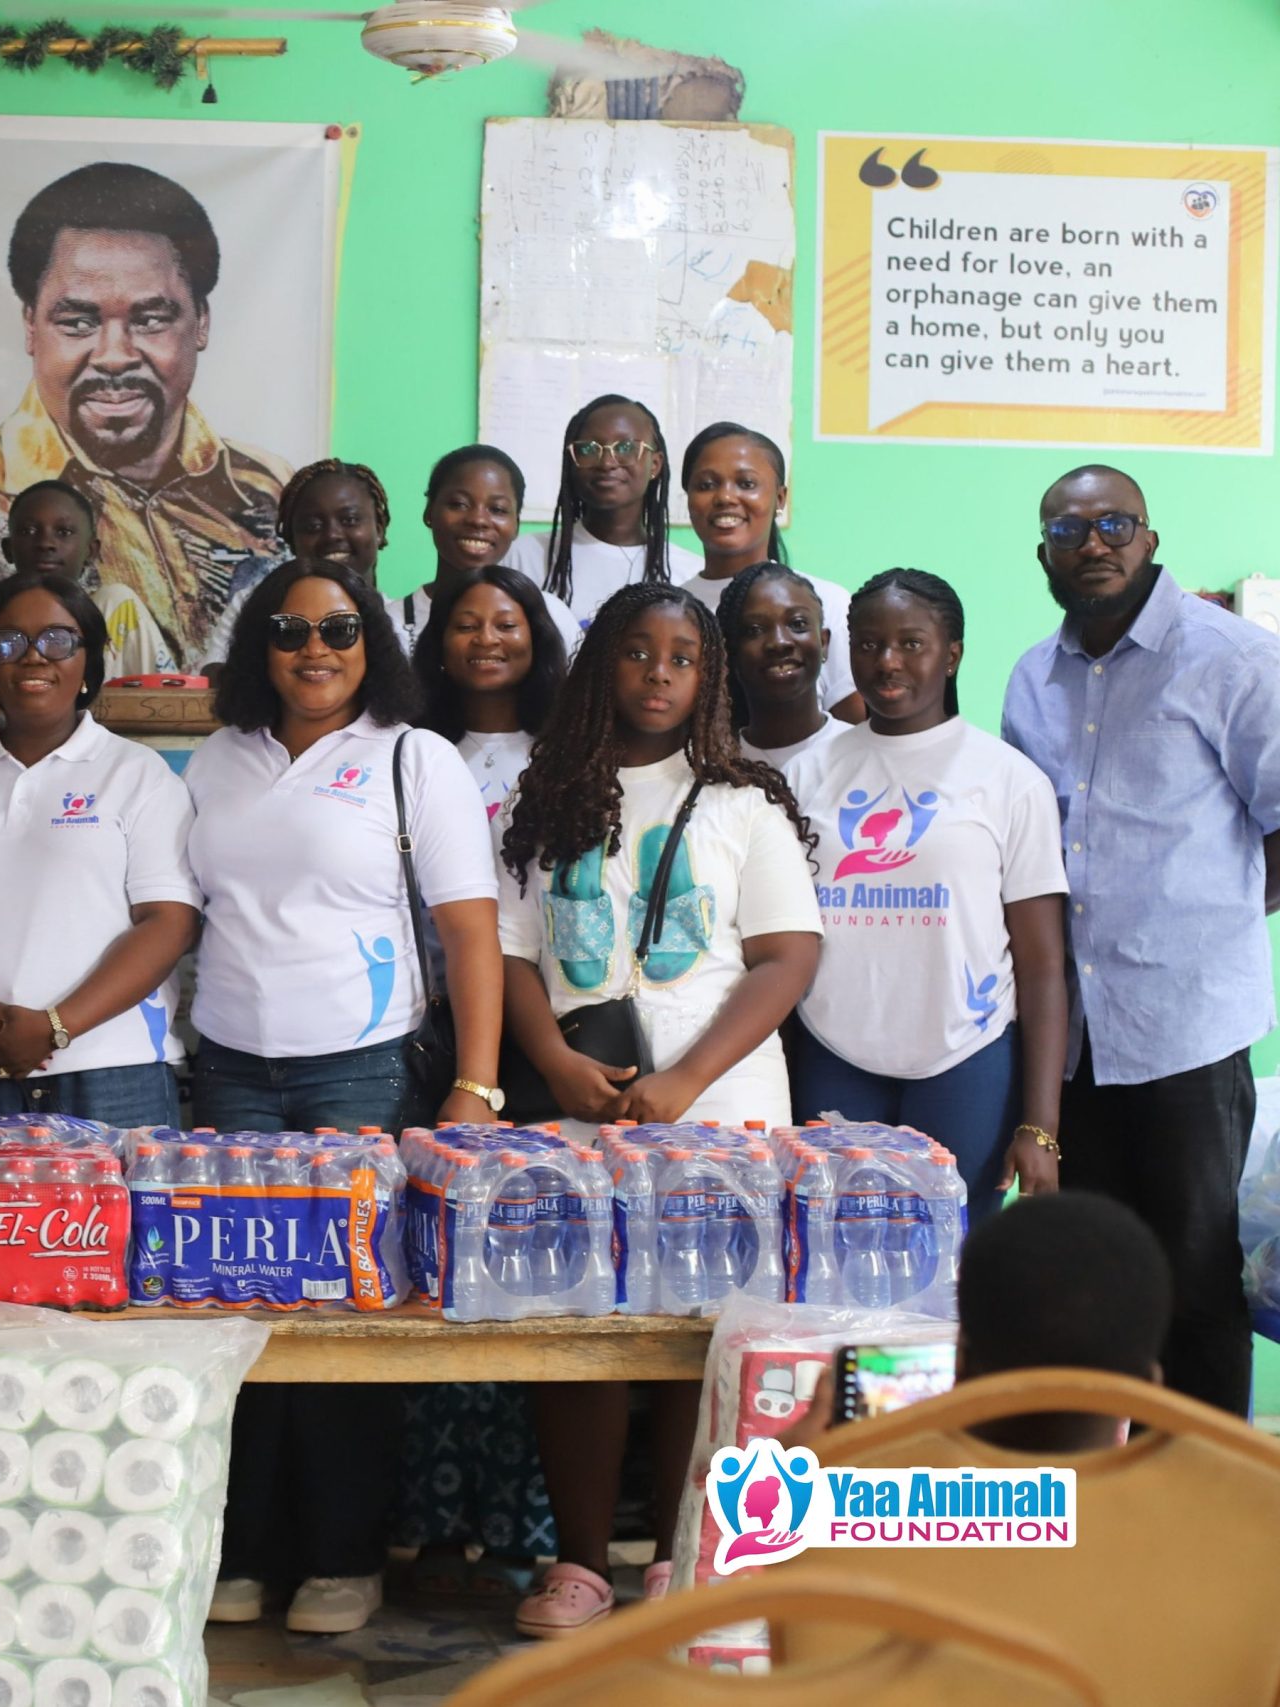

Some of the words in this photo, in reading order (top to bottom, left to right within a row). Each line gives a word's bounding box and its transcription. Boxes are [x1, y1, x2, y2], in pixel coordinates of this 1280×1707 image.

[886, 217, 998, 243] Children
[1009, 226, 1050, 244] are
[1061, 222, 1120, 246] born
[1132, 227, 1184, 249] with
[1194, 232, 1208, 250] a
[886, 252, 951, 274] need
[961, 253, 998, 275] for
[1009, 253, 1072, 280] love,
[1083, 260, 1113, 278] an
[886, 284, 1022, 312] orphanage
[1034, 291, 1078, 310] can
[1088, 292, 1142, 316] give
[1153, 291, 1218, 315] them
[885, 320, 899, 336] a
[910, 316, 988, 341] home,
[1001, 318, 1042, 341] but
[1053, 320, 1108, 348] only
[1118, 328, 1165, 349] you
[885, 351, 929, 370] can
[940, 350, 994, 376] give
[1005, 351, 1070, 374] them
[1081, 358, 1095, 375] a
[1106, 354, 1180, 378] heart.
[850, 882, 950, 909] Animah
[140, 1195, 168, 1206] 500ML
[355, 1199, 373, 1273] BOTTLES
[212, 1262, 257, 1277] MINERAL
[259, 1263, 293, 1278] WATER
[358, 1277, 376, 1299] 24
